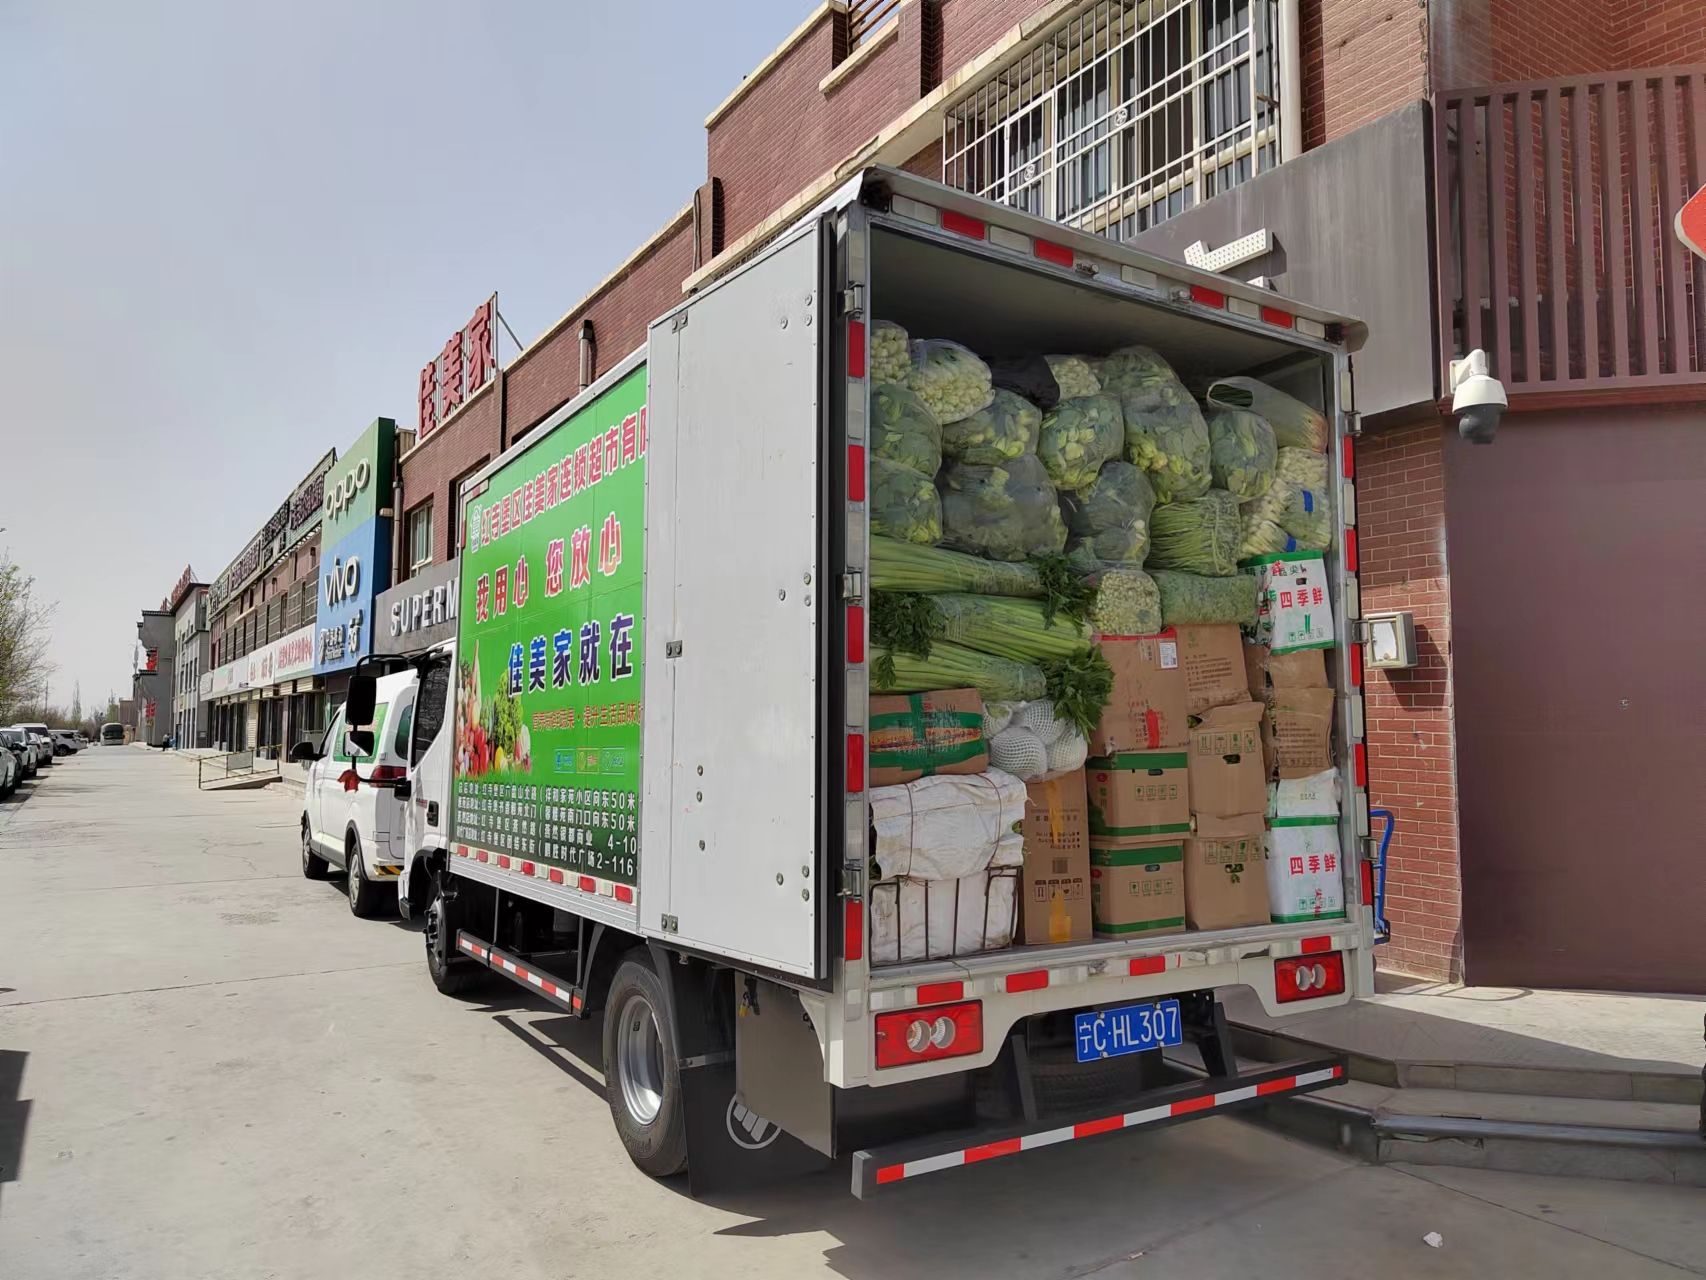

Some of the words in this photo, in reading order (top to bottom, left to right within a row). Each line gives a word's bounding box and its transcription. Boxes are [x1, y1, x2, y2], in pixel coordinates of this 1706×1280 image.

[418, 302, 496, 439] 佳美家
[324, 555, 360, 607] vivo
[476, 555, 529, 624] 我用心
[544, 511, 622, 598] 您放心
[1280, 586, 1324, 609] 四季鲜
[508, 613, 635, 697] 佳美家就在
[1289, 853, 1337, 875] 四季鲜
